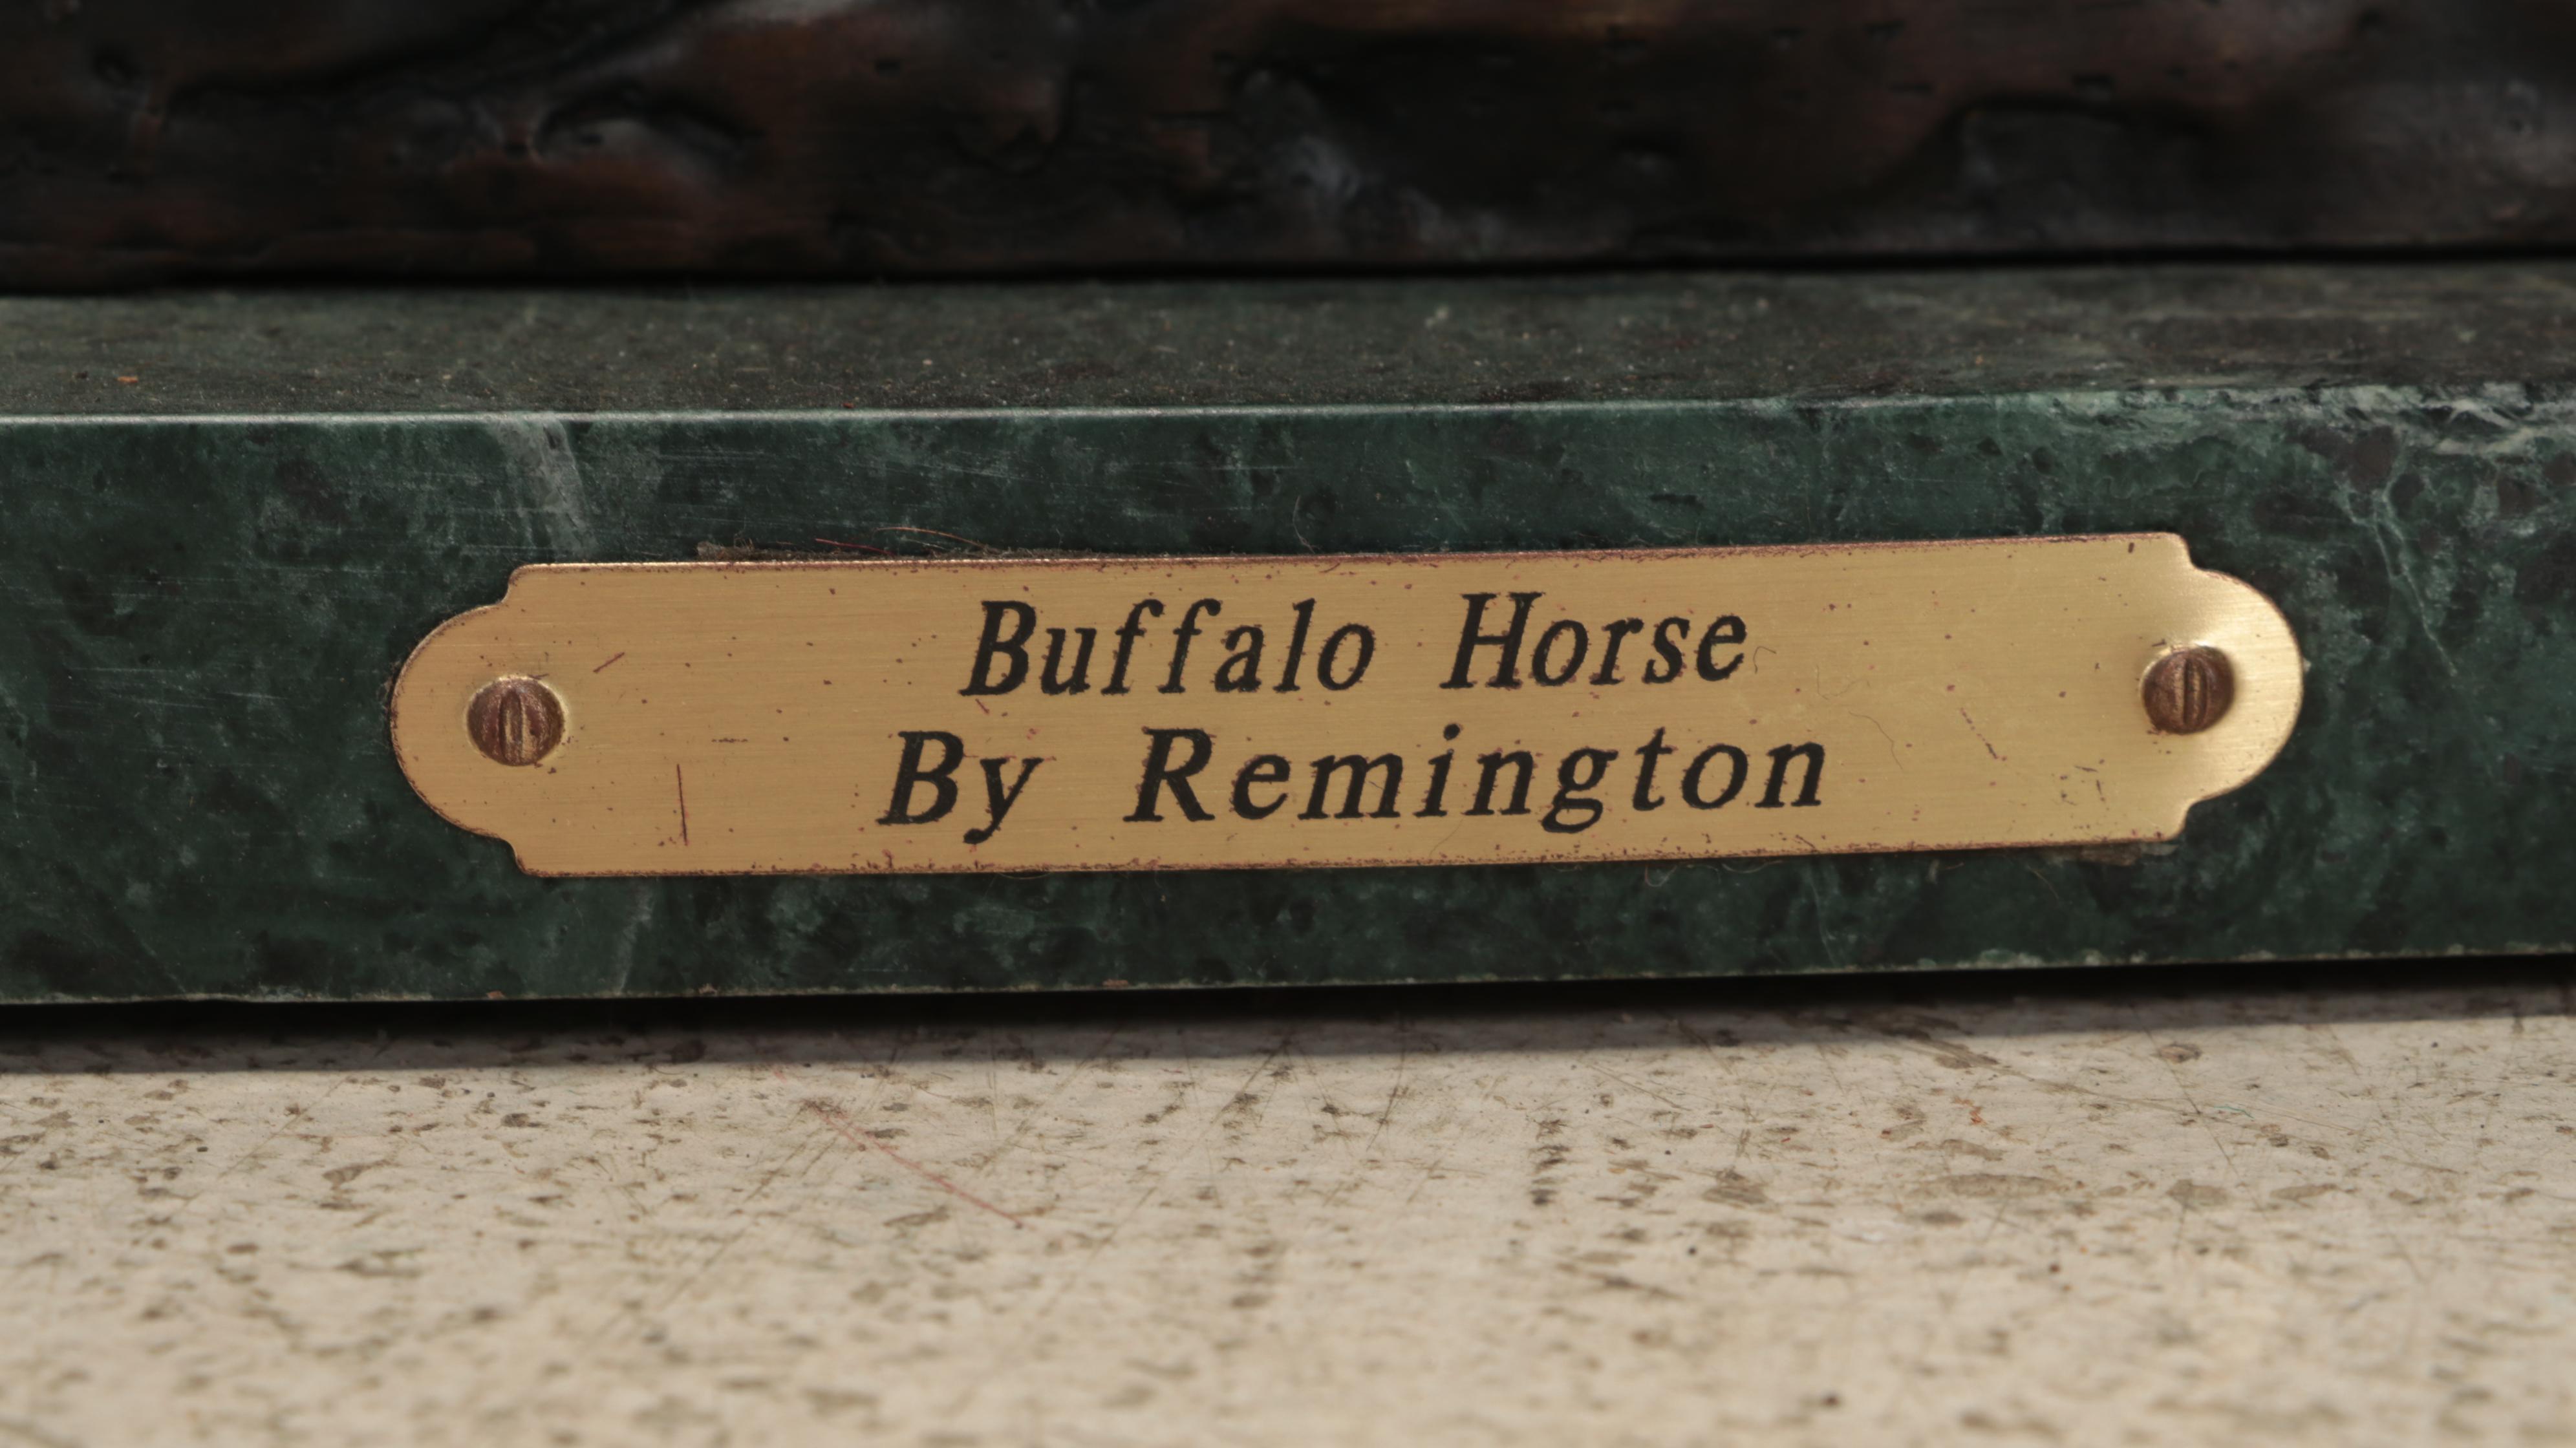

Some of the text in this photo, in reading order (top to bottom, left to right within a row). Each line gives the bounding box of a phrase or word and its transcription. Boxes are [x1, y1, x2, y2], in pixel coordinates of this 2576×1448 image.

[958, 591, 1747, 697] Buffalo Horse
[875, 723, 1825, 846] By Remington
